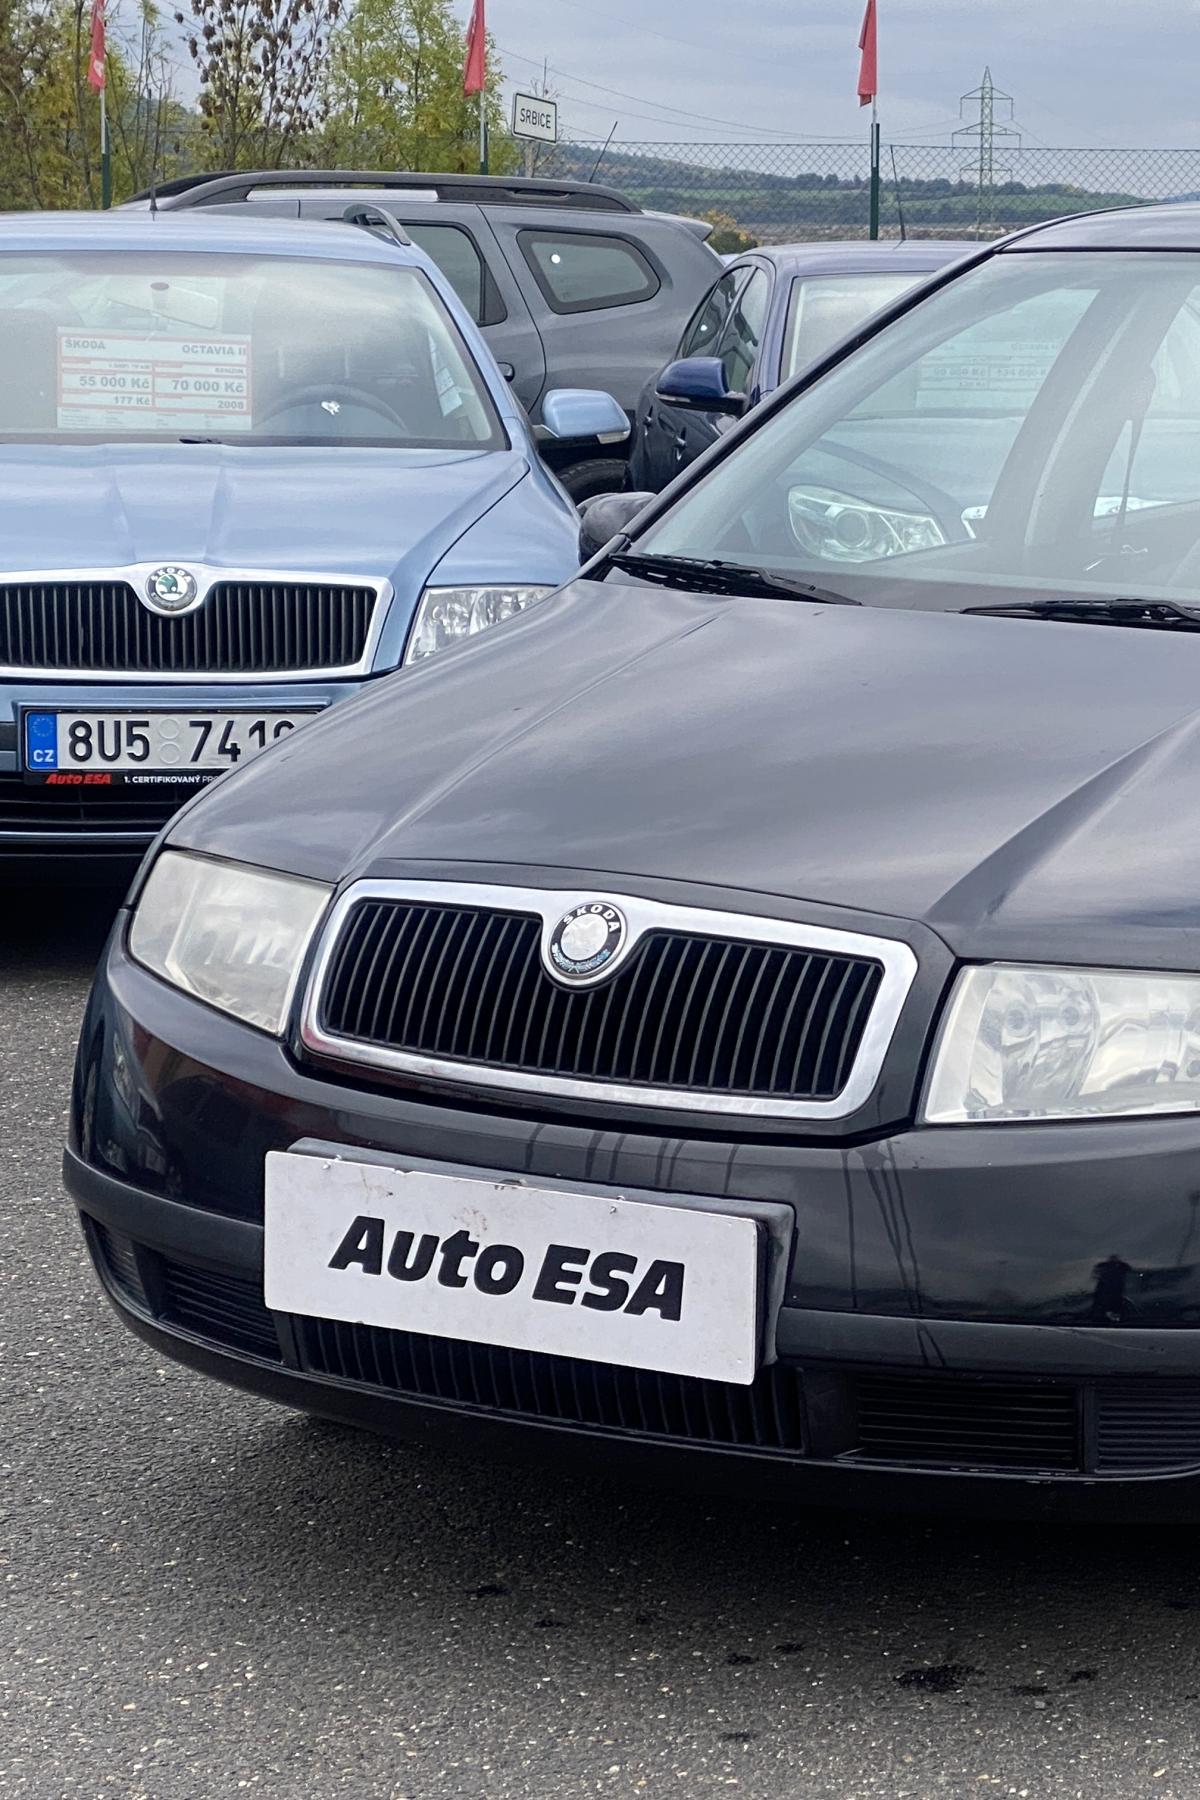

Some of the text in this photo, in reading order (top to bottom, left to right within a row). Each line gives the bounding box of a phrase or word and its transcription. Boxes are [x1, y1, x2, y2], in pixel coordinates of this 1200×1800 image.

[519, 107, 552, 129] SRBICE
[181, 344, 234, 355] OCTAVIA
[79, 375, 150, 389] 55 000 Kč
[171, 379, 245, 393] 70 000 Kč
[114, 395, 133, 404] 177
[68, 719, 151, 763] 8U5
[33, 749, 55, 763] CZ
[45, 773, 112, 785] Auto ESA
[132, 774, 201, 784] CERTIFIKOVANÝ
[327, 1215, 686, 1322] Auto ESA
